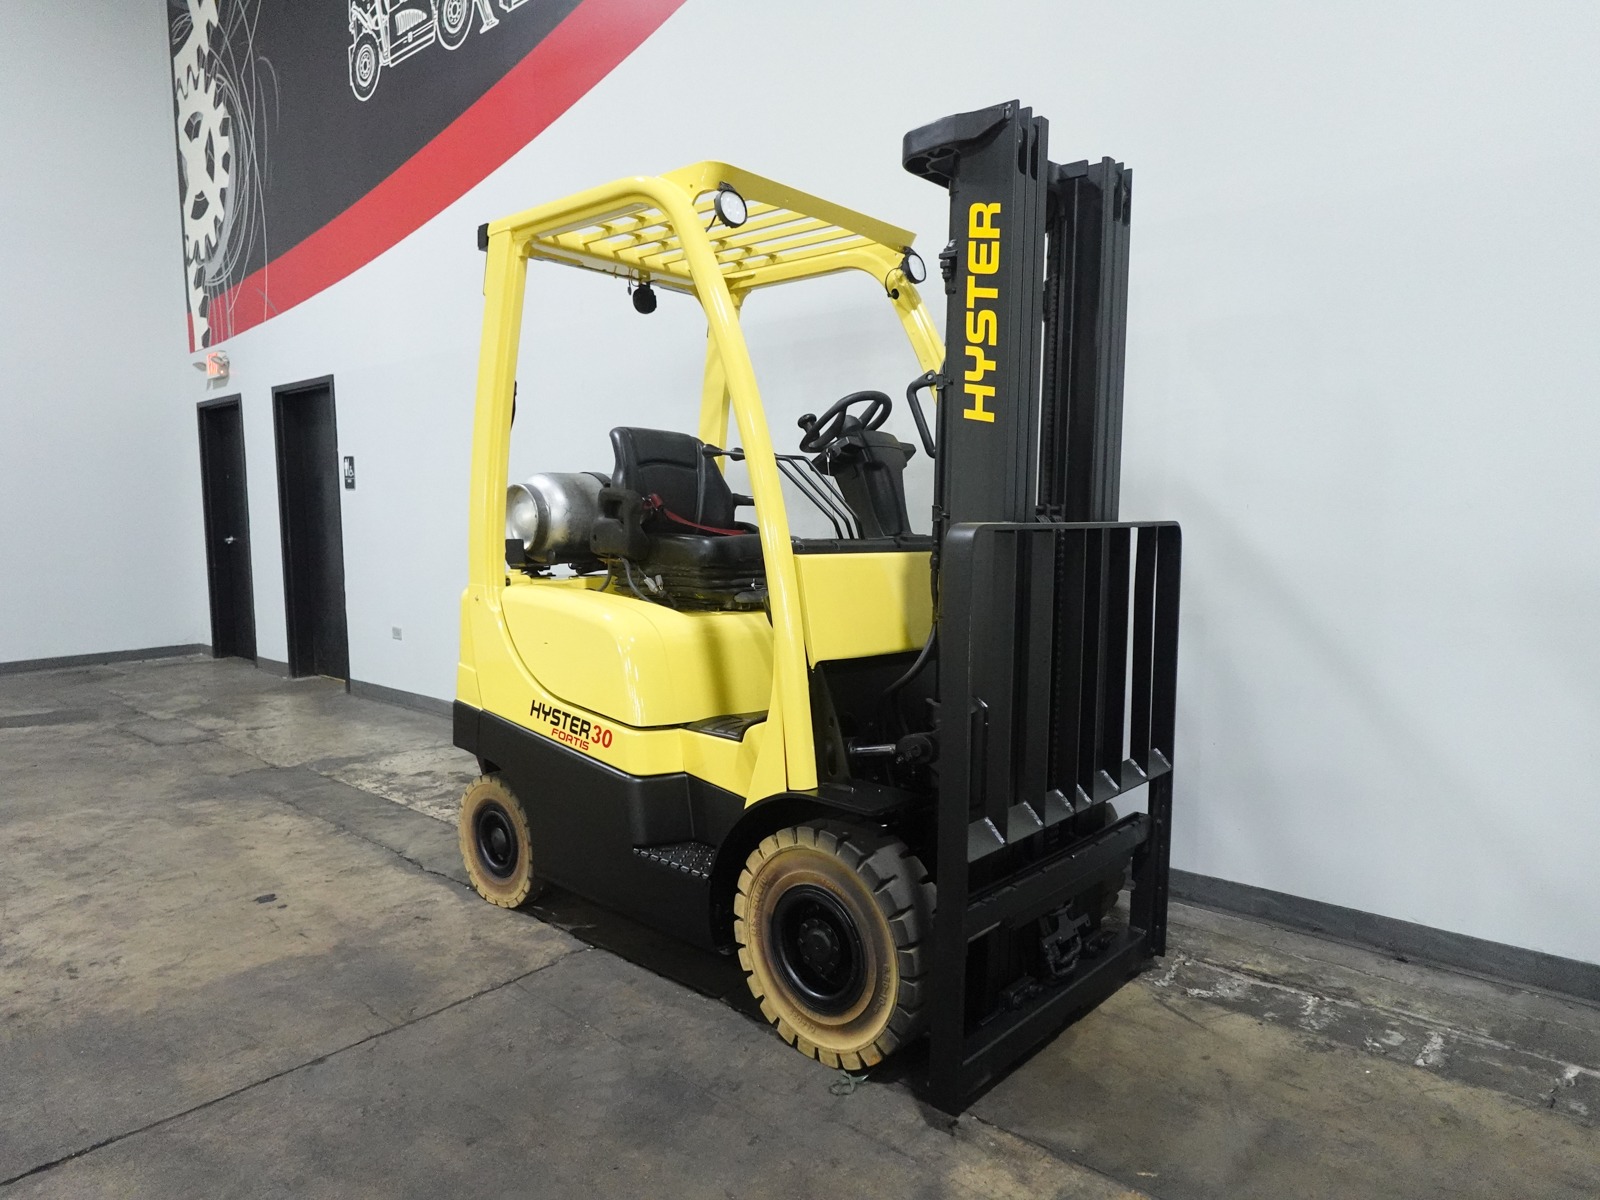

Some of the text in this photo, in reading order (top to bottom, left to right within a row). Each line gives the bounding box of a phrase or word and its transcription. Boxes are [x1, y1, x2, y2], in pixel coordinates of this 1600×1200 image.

[963, 202, 1001, 423] HYSTER
[530, 700, 613, 748] HYSTER 30
[551, 728, 590, 751] FORTIS
